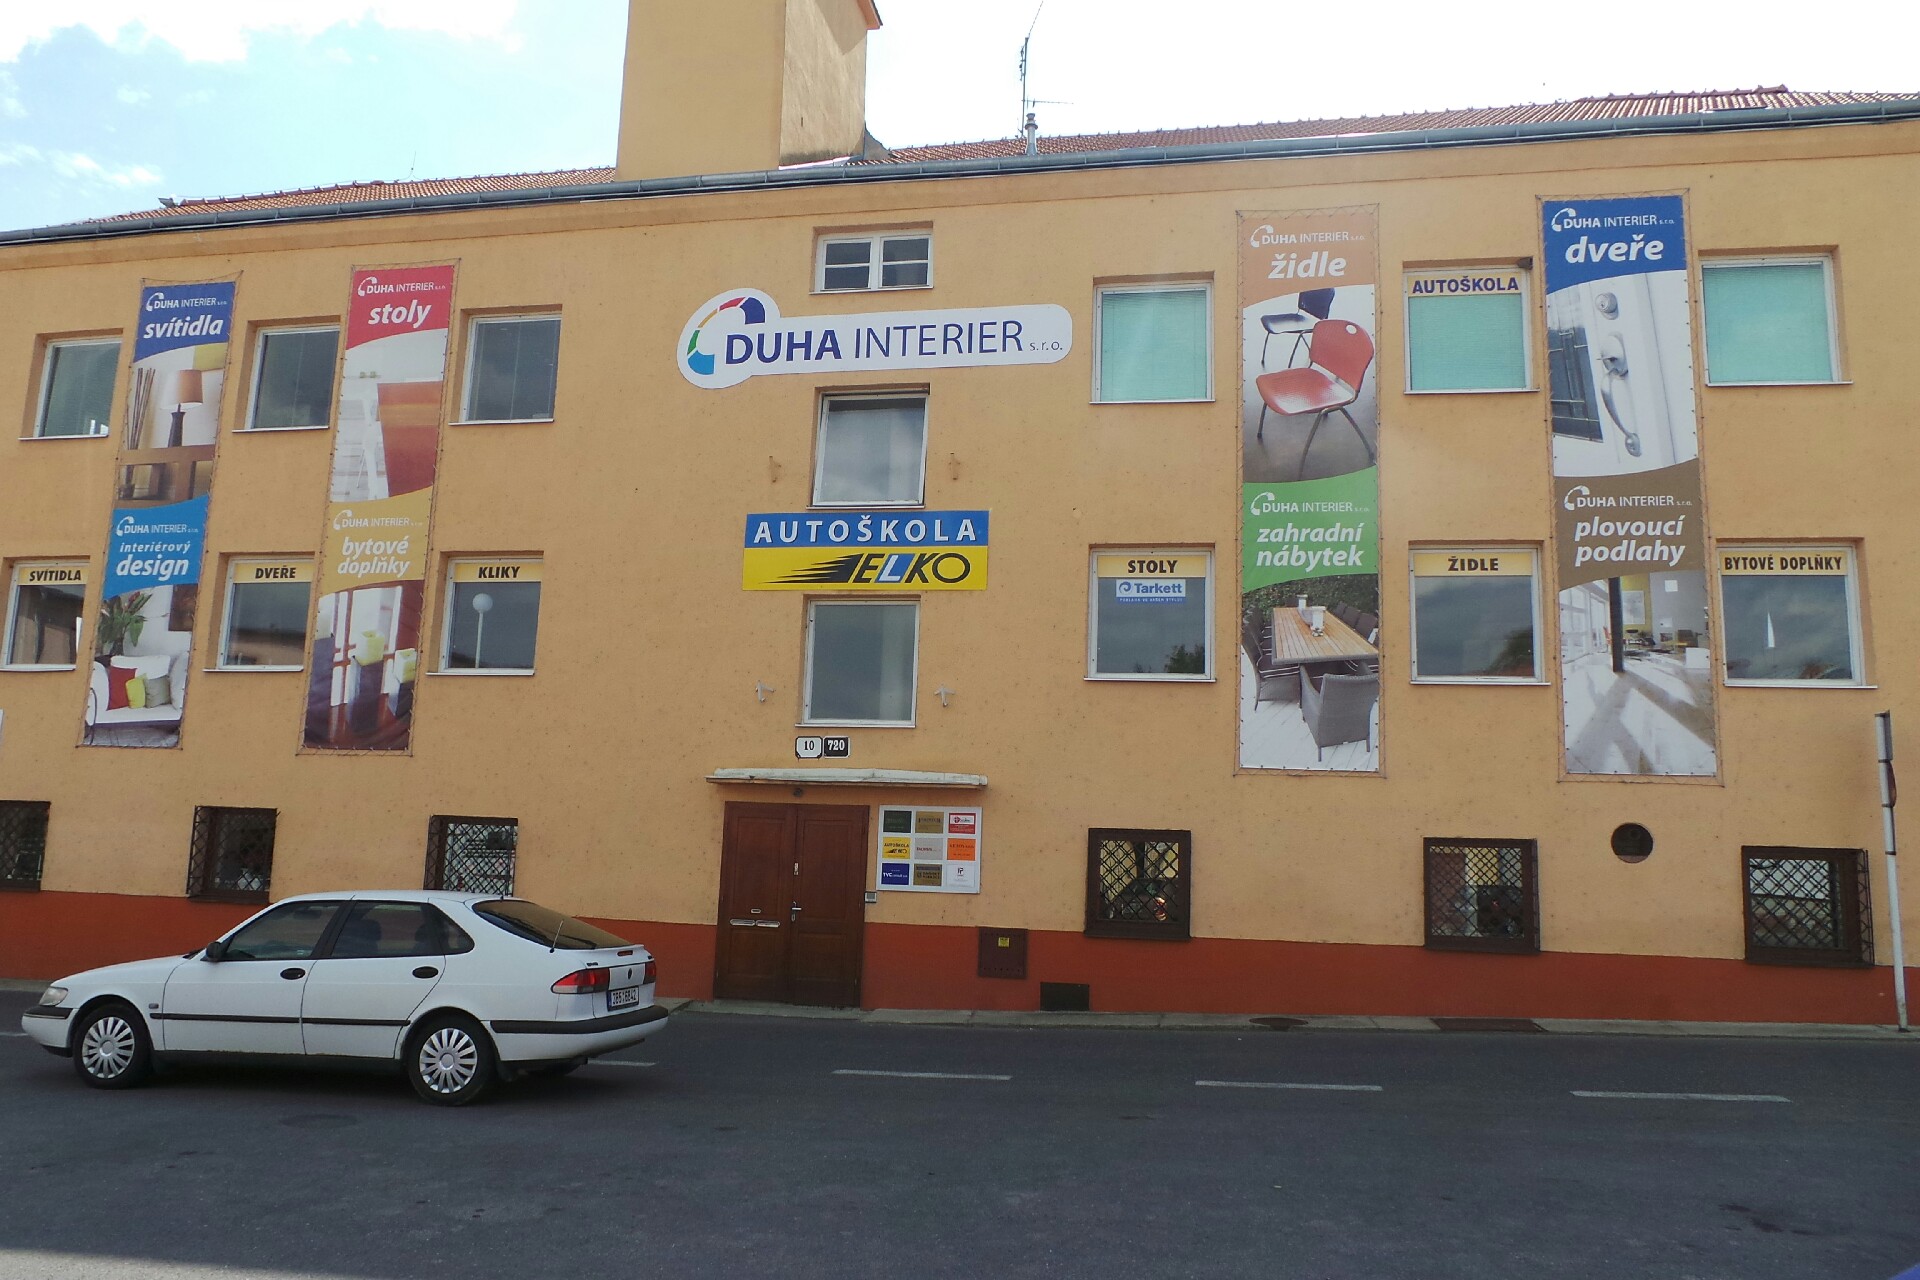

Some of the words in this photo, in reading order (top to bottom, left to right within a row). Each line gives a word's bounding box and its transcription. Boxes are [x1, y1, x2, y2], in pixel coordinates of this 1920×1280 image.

[1563, 217, 1601, 229] DUHA
[1603, 214, 1657, 228] INTERIER
[1261, 234, 1297, 245] DUHA
[1300, 231, 1349, 243] INTERIER
[1565, 233, 1664, 264] dveře
[1268, 251, 1347, 279] židle
[366, 284, 394, 294] DUHA
[396, 282, 434, 292] INTERIER
[1412, 275, 1519, 294] AUTOŠKOLA
[154, 299, 180, 309] DUHA
[181, 297, 217, 307] INTERIER
[368, 299, 432, 329] stoly
[143, 314, 224, 339] svítidla
[725, 329, 842, 365] DUHA
[854, 320, 1024, 359] INTERIER
[1029, 340, 1064, 352] s.r.o.
[1262, 502, 1299, 513] DUHA
[1302, 501, 1353, 512] INTERIER
[1576, 496, 1617, 508] DUHA
[1619, 495, 1674, 507] INTERIER
[124, 524, 150, 534] DUHA
[151, 523, 187, 533] INTERIER
[342, 518, 369, 528] DUHA
[371, 517, 410, 527] INTERIER
[753, 515, 977, 544] AUTOŠKOLA
[1574, 514, 1686, 542] plovoucí
[1256, 522, 1365, 543] zahradní
[119, 540, 191, 554] interiérový
[342, 535, 410, 560] bytové
[1574, 539, 1686, 567] podlahy
[1127, 560, 1178, 573] STOLY
[1256, 544, 1365, 573] nábytek
[1447, 556, 1499, 572] ŽIDLE
[1724, 554, 1774, 571] BYTOVÉ
[1780, 554, 1842, 571] DOPLŇKY
[29, 568, 82, 582] SVÍTIDLA
[116, 554, 189, 582] design
[255, 565, 297, 579] DVEŘE
[337, 556, 410, 578] doplňky
[478, 566, 521, 579] KLIKY
[852, 553, 971, 584] ELKO
[1134, 583, 1183, 593] Tarkett
[804, 740, 815, 751] 10
[827, 740, 845, 751] 720
